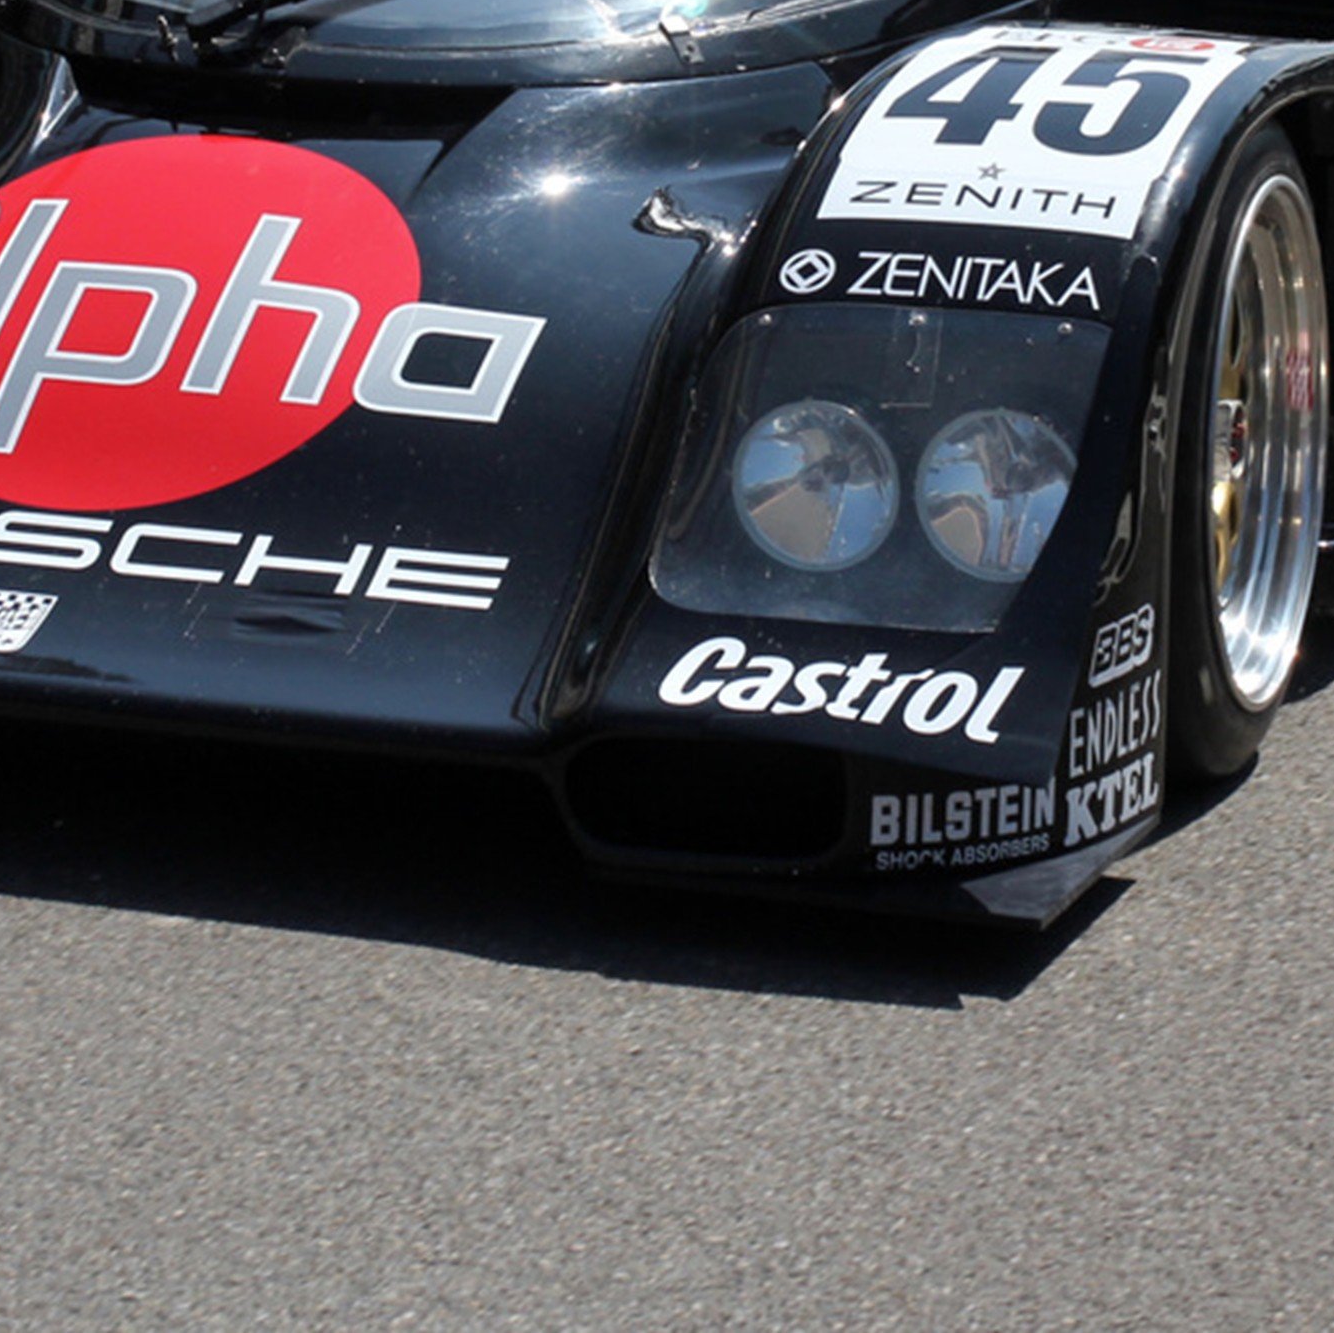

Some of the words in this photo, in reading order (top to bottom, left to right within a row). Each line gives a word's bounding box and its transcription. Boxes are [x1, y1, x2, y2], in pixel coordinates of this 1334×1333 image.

[883, 45, 1211, 156] 45
[849, 180, 1117, 220] ZENITH
[846, 251, 1101, 310] ZENITAKA
[1087, 603, 1156, 688] BBS
[658, 636, 1025, 743] Castrol
[1069, 668, 1162, 779] ENDLESS
[870, 775, 1057, 846] BILSTEIN
[1063, 752, 1160, 847] KTEL
[876, 848, 946, 870] SHOCK
[949, 832, 1051, 866] ABSORBERS
